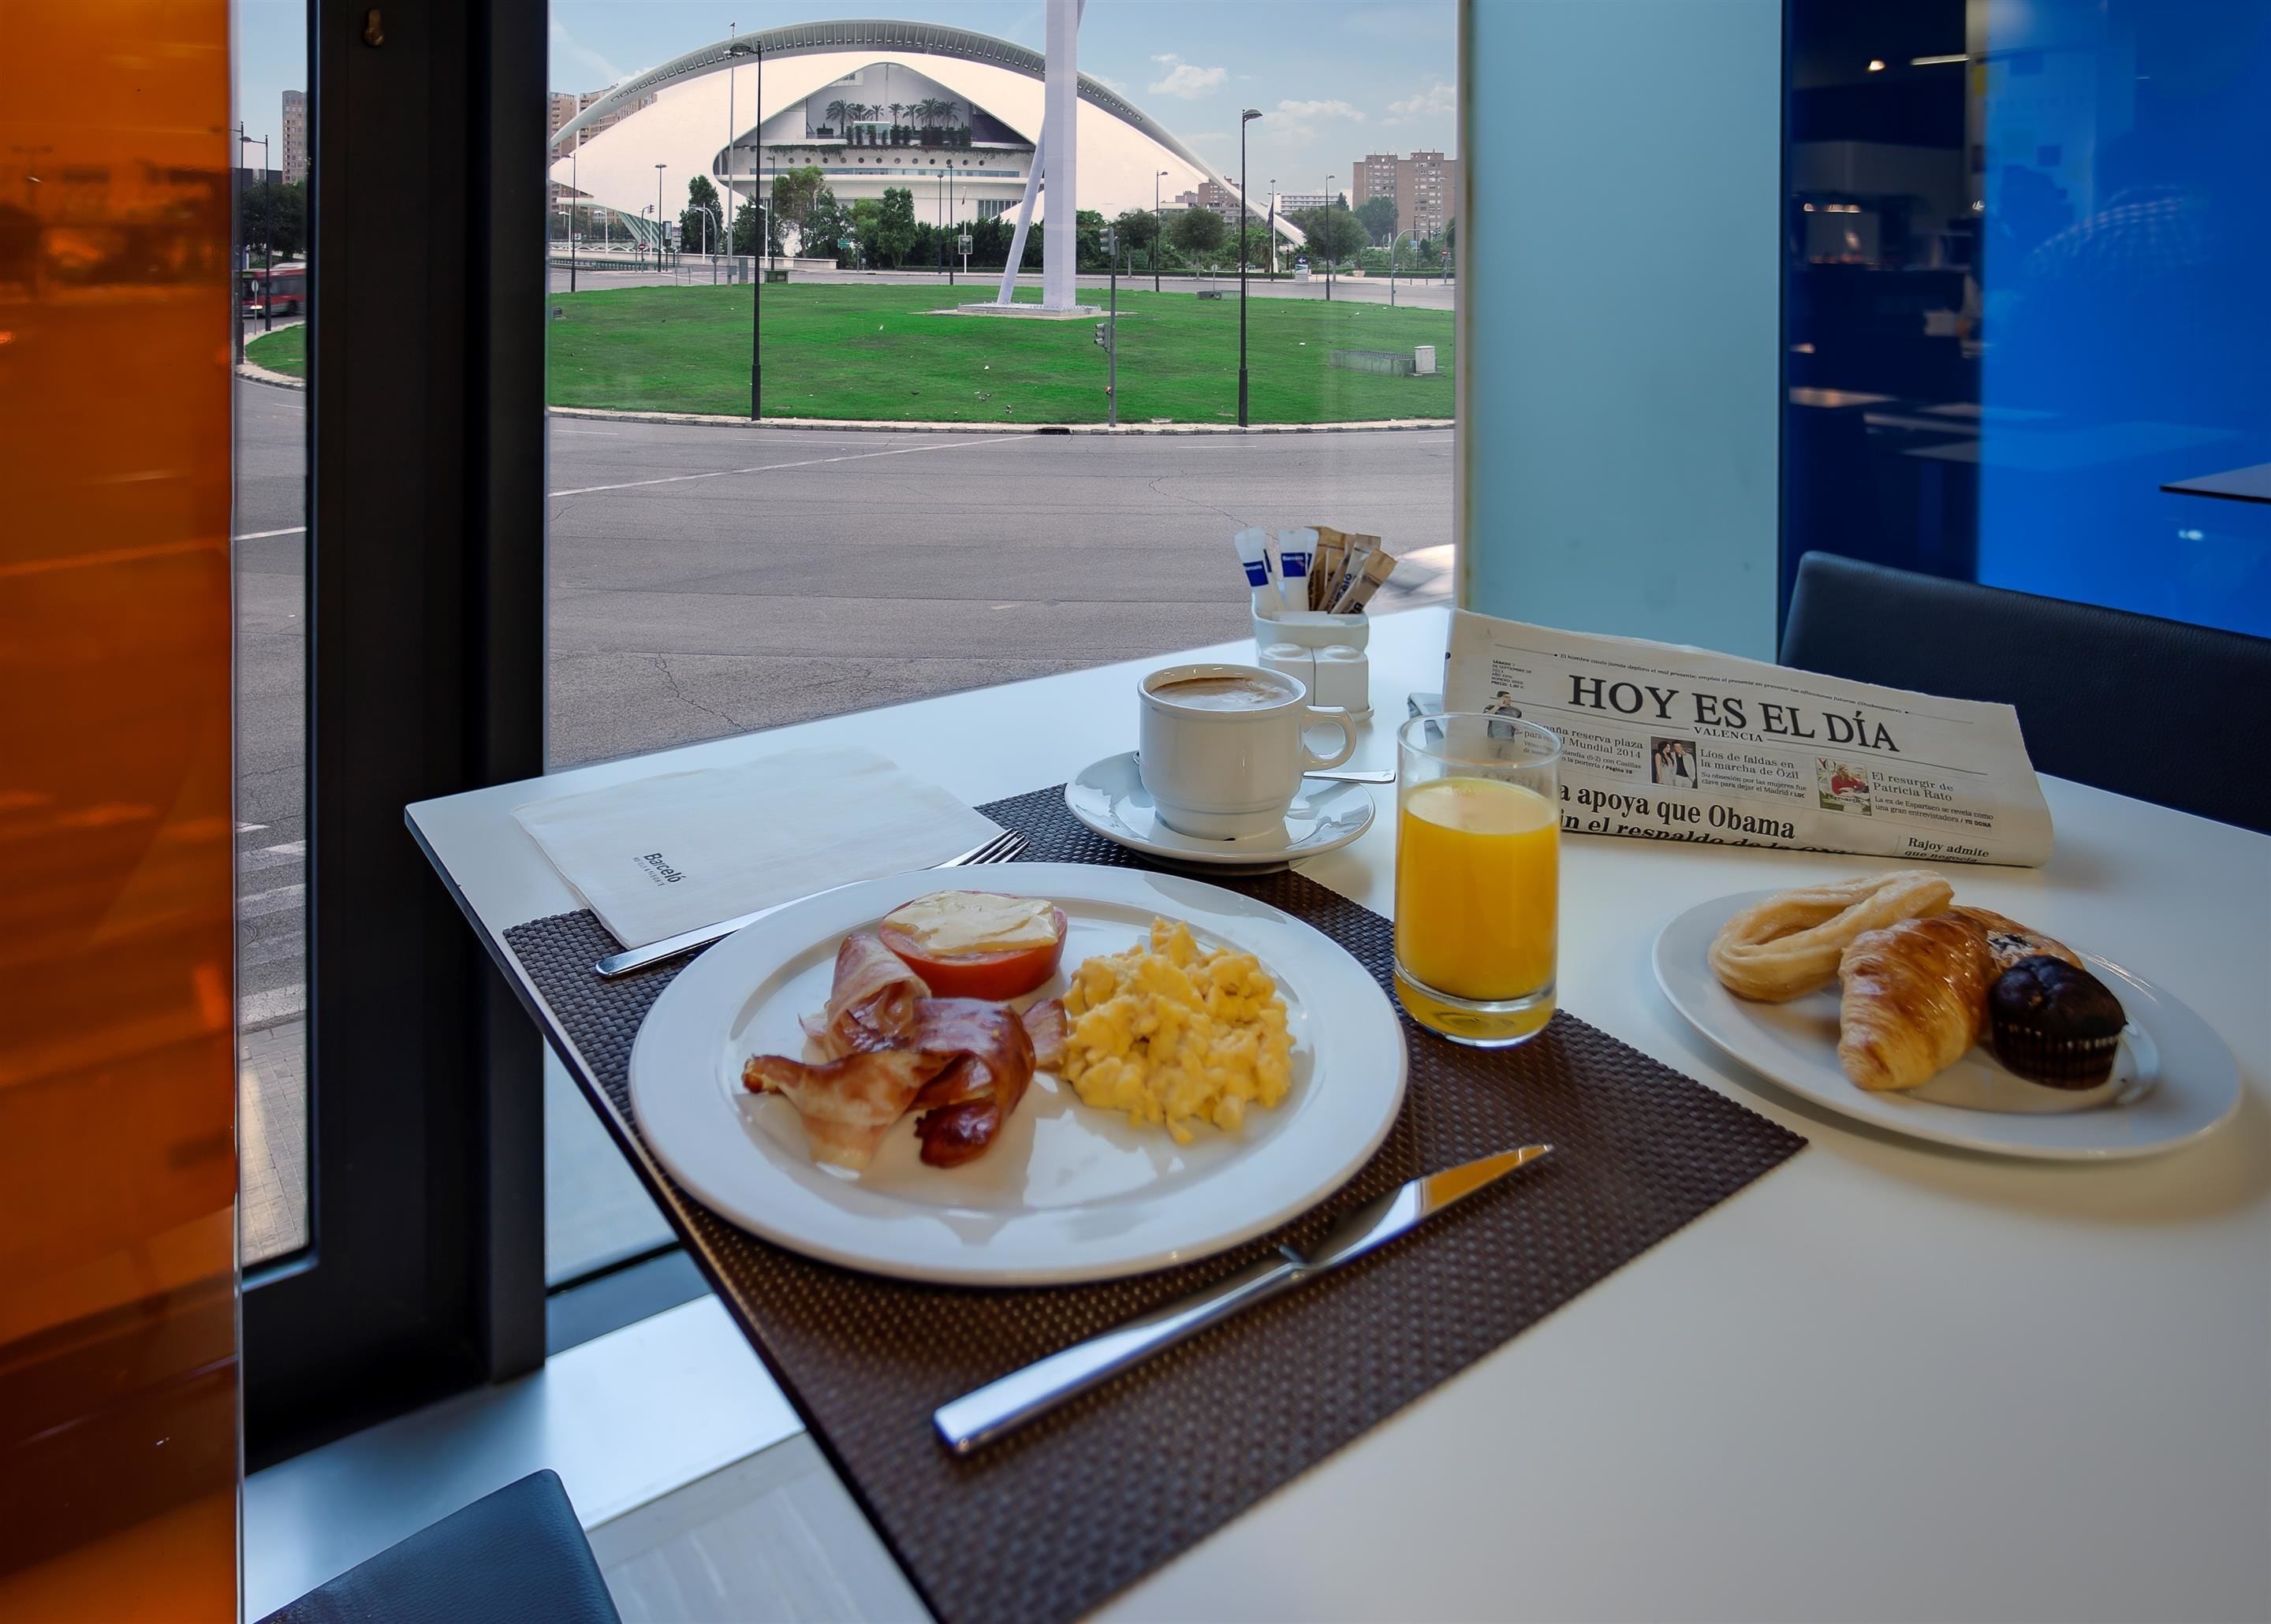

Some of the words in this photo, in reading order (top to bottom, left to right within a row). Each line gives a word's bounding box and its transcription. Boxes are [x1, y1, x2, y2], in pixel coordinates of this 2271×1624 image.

[1568, 675, 1680, 719] HOY
[1691, 693, 1747, 729] ES
[1758, 702, 1815, 739] EL
[1822, 710, 1900, 752] DÍA
[1572, 730, 1611, 743] reserva
[1614, 738, 1643, 749] plaza
[1694, 726, 1763, 743] VALENCIA
[1569, 738, 1613, 754] Mundial
[1617, 747, 1640, 758] 2014
[1700, 749, 1724, 760] Líos
[1727, 753, 1740, 762] de
[1743, 754, 1777, 767] faldas
[1617, 760, 1642, 769] Casillas
[1701, 759, 1711, 768] la
[1714, 762, 1756, 774] marcha
[1759, 767, 1773, 776] de
[1776, 768, 1799, 779] Özil
[1711, 773, 1741, 782] obsesión
[1767, 780, 1795, 790] mujeres
[1737, 782, 1755, 792] dejar
[1763, 787, 1788, 796] Madrid
[1872, 771, 1883, 780] El
[1888, 775, 1936, 789] resurgir
[1939, 783, 1954, 792] de
[1874, 782, 1920, 796] Patricia
[1924, 789, 1952, 802] Rato
[1577, 788, 1650, 818] apoya
[1657, 799, 1701, 825] que
[1708, 804, 1796, 840] Obama
[1905, 800, 1940, 813] Espartaco
[1908, 809, 1959, 823] entrevistadora
[1588, 817, 1610, 832] el
[1615, 824, 1725, 844] respaldo
[1908, 837, 1945, 852] Rajoy
[1946, 845, 1989, 858] admite
[643, 853, 687, 883] Barceló
